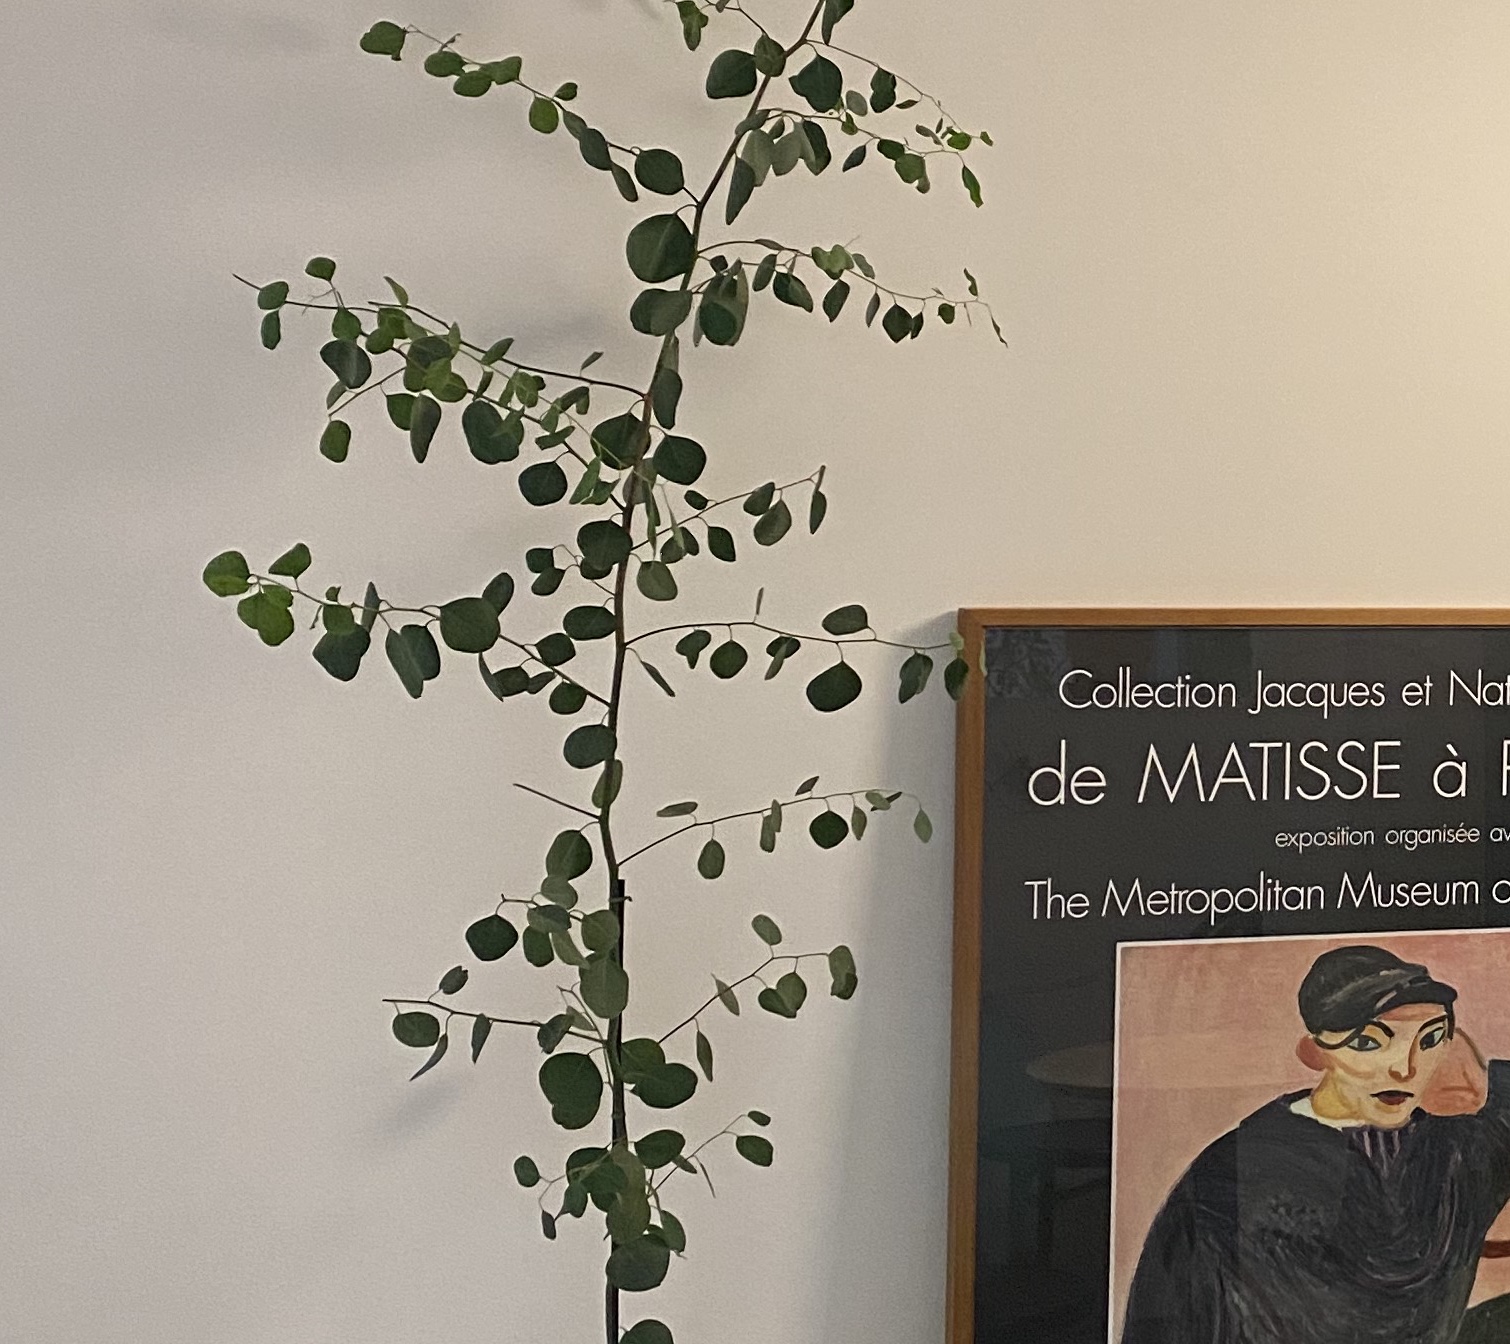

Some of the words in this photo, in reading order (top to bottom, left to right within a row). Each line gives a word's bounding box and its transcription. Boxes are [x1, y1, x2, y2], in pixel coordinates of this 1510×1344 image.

[1058, 667, 1236, 709] Collection
[1248, 669, 1386, 720] Jacques
[1401, 674, 1434, 707] et
[1028, 738, 1107, 806] de
[1137, 740, 1402, 804] MATISSE
[1432, 743, 1468, 799] à
[1275, 825, 1375, 854] exposition
[1385, 822, 1480, 852] organisée
[1024, 878, 1090, 920] The
[1101, 870, 1325, 925] Metropolitan
[1336, 870, 1479, 909] Museum
